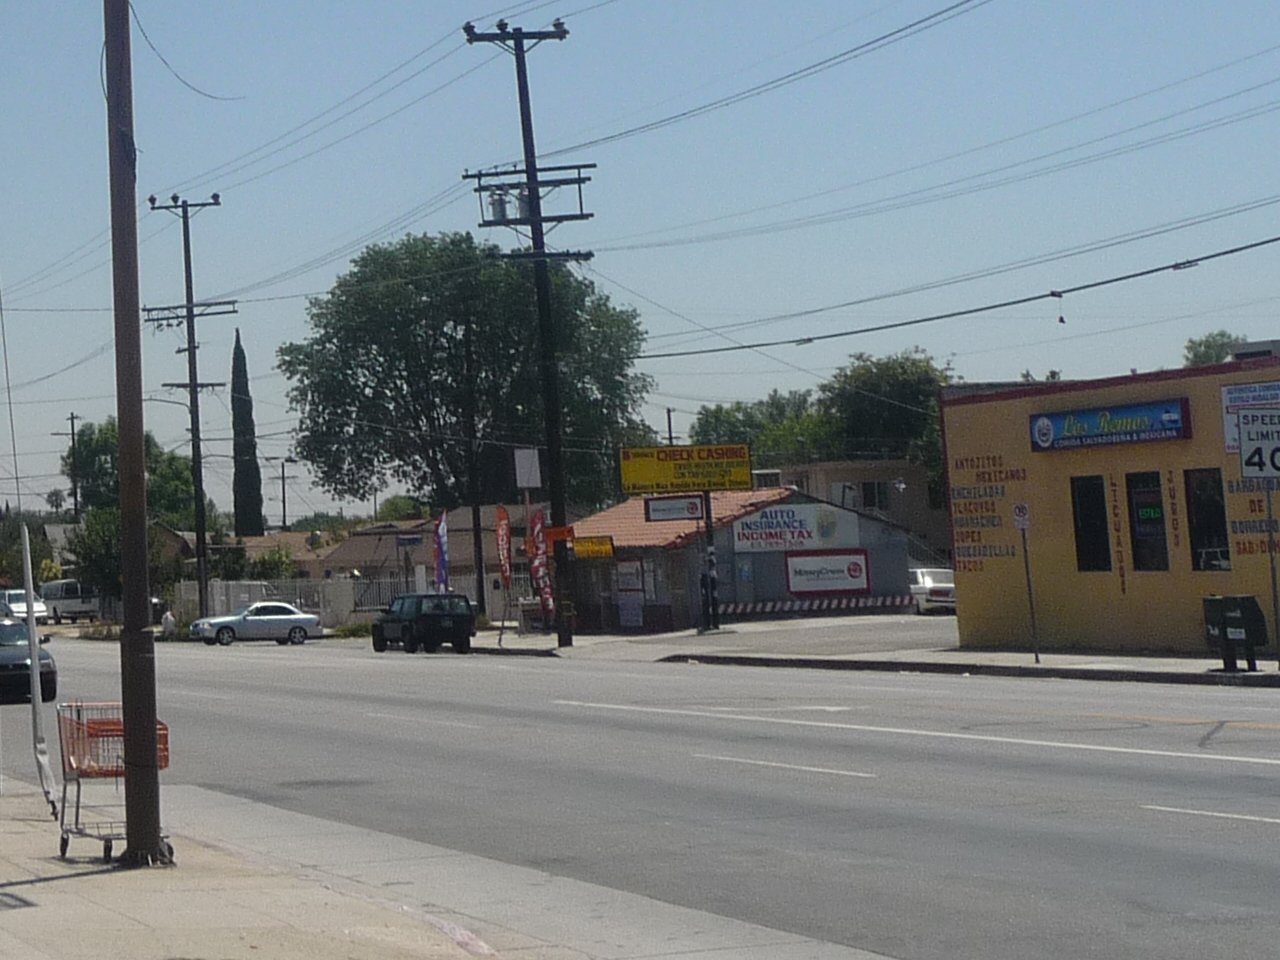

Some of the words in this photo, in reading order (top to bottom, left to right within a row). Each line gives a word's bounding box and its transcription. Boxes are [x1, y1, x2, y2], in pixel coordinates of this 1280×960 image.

[1242, 414, 1280, 426] SPEE
[1054, 437, 1081, 448] COMIDA
[1139, 429, 1177, 441] MEXICANA
[656, 449, 694, 462] CHECK
[697, 446, 747, 460] CASHING
[976, 468, 1027, 483] MEXICANOS
[951, 485, 1005, 499] ENCHILADAS
[1249, 499, 1265, 514] DE
[760, 508, 796, 521] AUTO
[741, 519, 808, 531] INSURANCE
[737, 530, 787, 542] INCOME
[789, 529, 814, 540] TAX
[957, 560, 984, 573] TACOS
